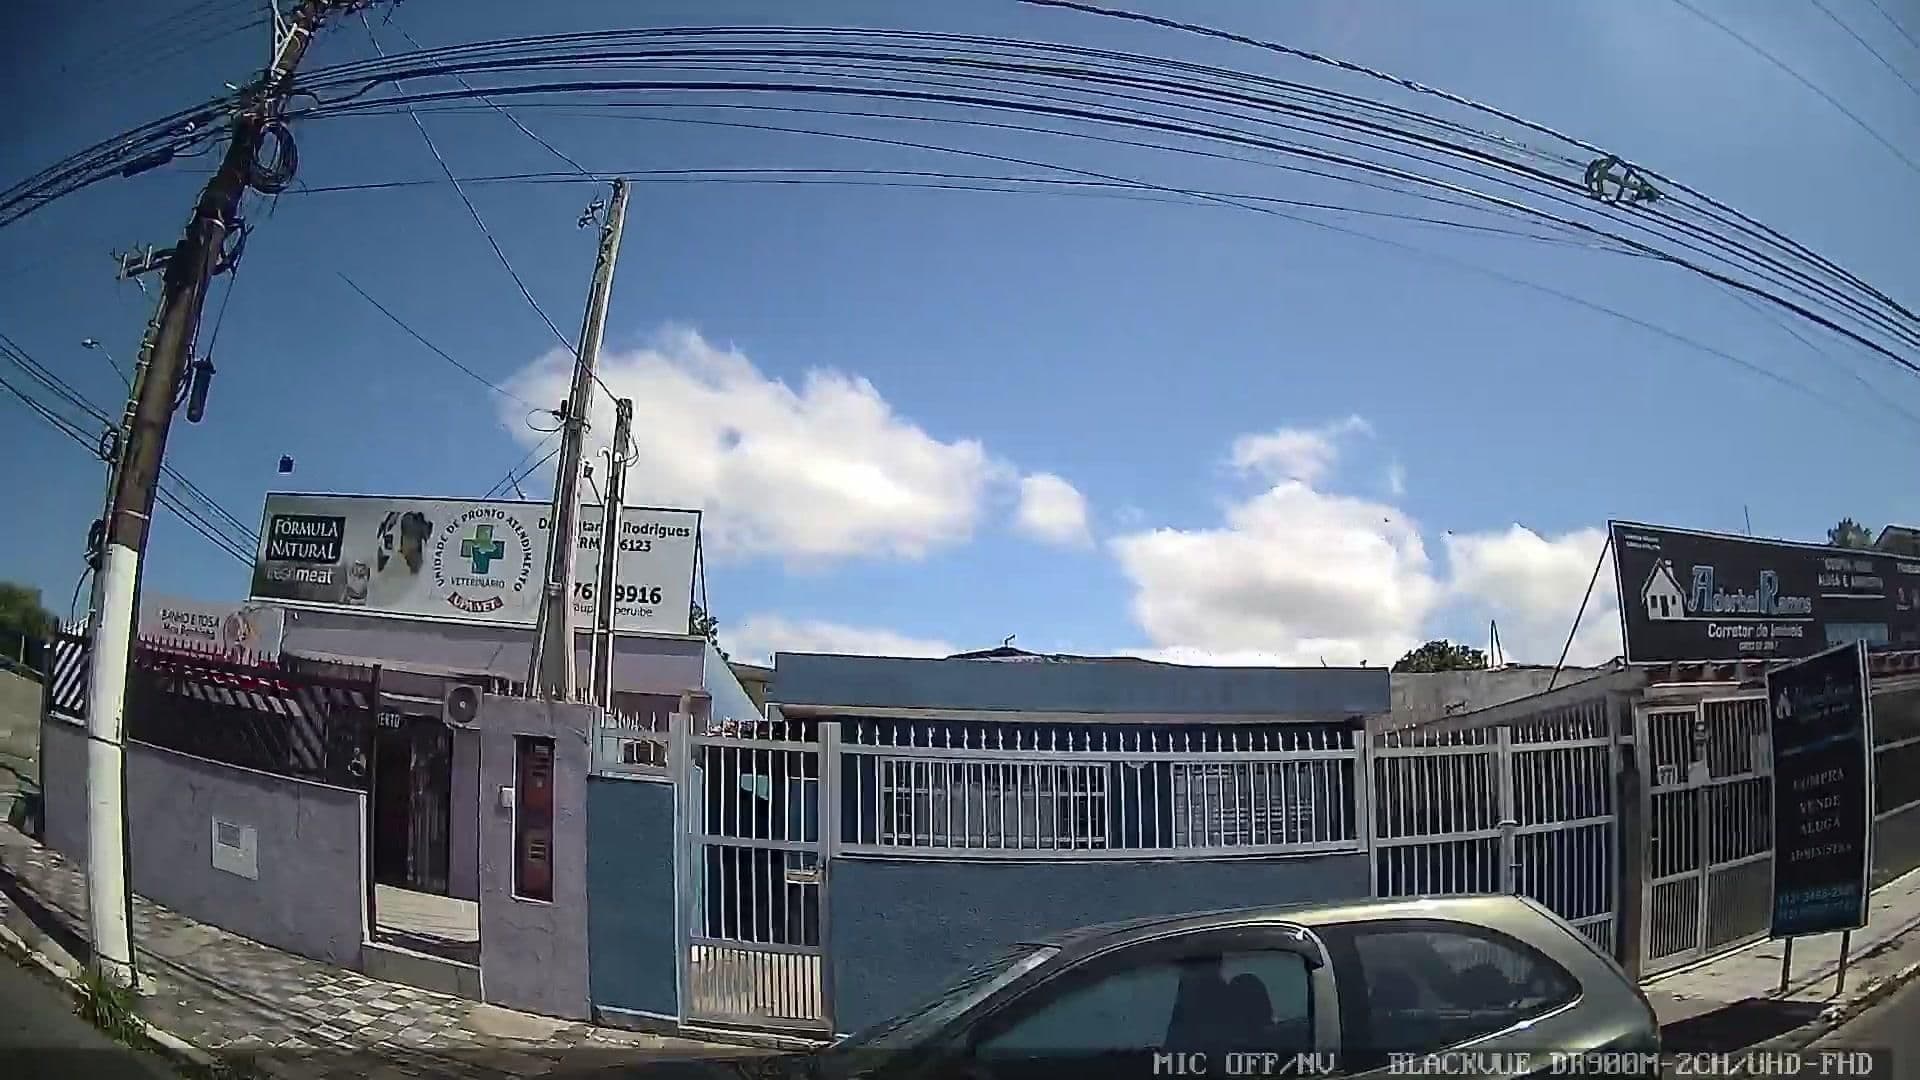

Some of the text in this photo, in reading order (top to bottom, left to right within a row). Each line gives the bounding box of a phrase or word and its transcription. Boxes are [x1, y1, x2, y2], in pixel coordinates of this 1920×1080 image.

[275, 517, 338, 537] FÓRMULA
[623, 521, 690, 539] Rodrigues
[271, 540, 336, 560] NATURAL
[433, 508, 532, 592] UNIDADE DE PRONTO ATENDIMENTO
[620, 539, 652, 552] 6123
[1759, 569, 1812, 615] Ramos
[1707, 623, 1754, 638] Corretor
[1799, 795, 1841, 814] VENDE
[1800, 818, 1841, 837] ALUGA
